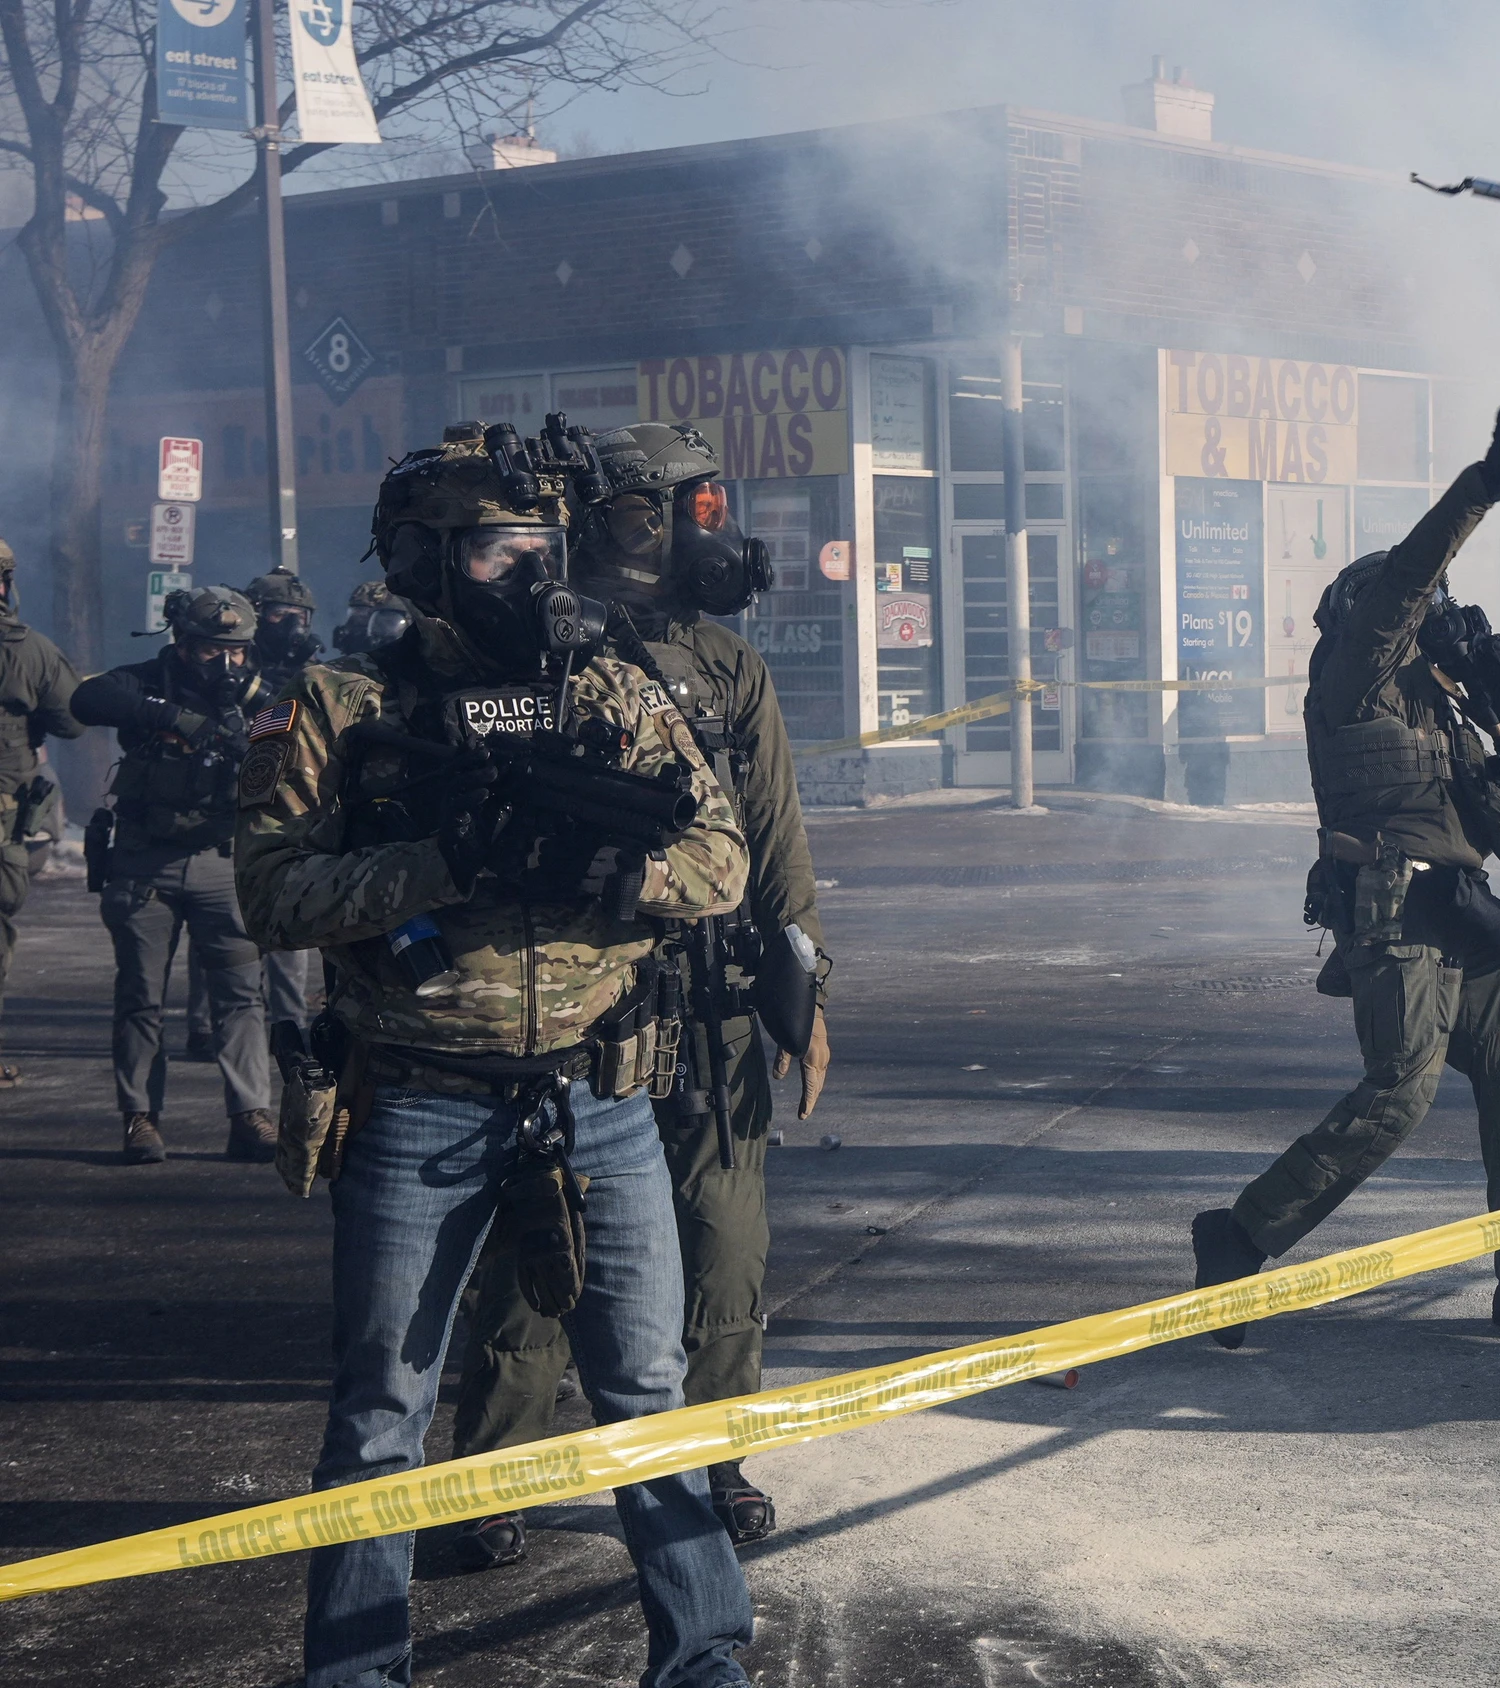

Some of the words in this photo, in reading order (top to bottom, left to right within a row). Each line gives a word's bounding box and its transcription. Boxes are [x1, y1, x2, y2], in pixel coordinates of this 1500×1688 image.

[166, 50, 192, 65] eat
[194, 53, 238, 70] street
[303, 71, 322, 83] eat
[324, 74, 358, 87] street
[167, 88, 193, 102] eating
[196, 92, 238, 104] adventure
[328, 333, 350, 372] 8
[640, 349, 842, 421] TOBACCO
[1170, 350, 1356, 425] TOBACCO
[722, 413, 815, 481] MAS
[1201, 416, 1229, 478] &
[1249, 419, 1329, 484] MAS
[1181, 519, 1249, 541] Unlimited
[1182, 590, 1205, 599] Canada
[882, 600, 928, 631] BACKWOODS
[1182, 613, 1214, 630] Plans
[1218, 610, 1252, 648] $19
[753, 623, 821, 655] GLASS
[1182, 636, 1206, 648] Starting
[1207, 639, 1215, 647] at
[465, 696, 551, 719] POLICE
[1207, 692, 1233, 703] Mobile
[495, 716, 554, 733] BORTAC
[892, 693, 910, 740] BT
